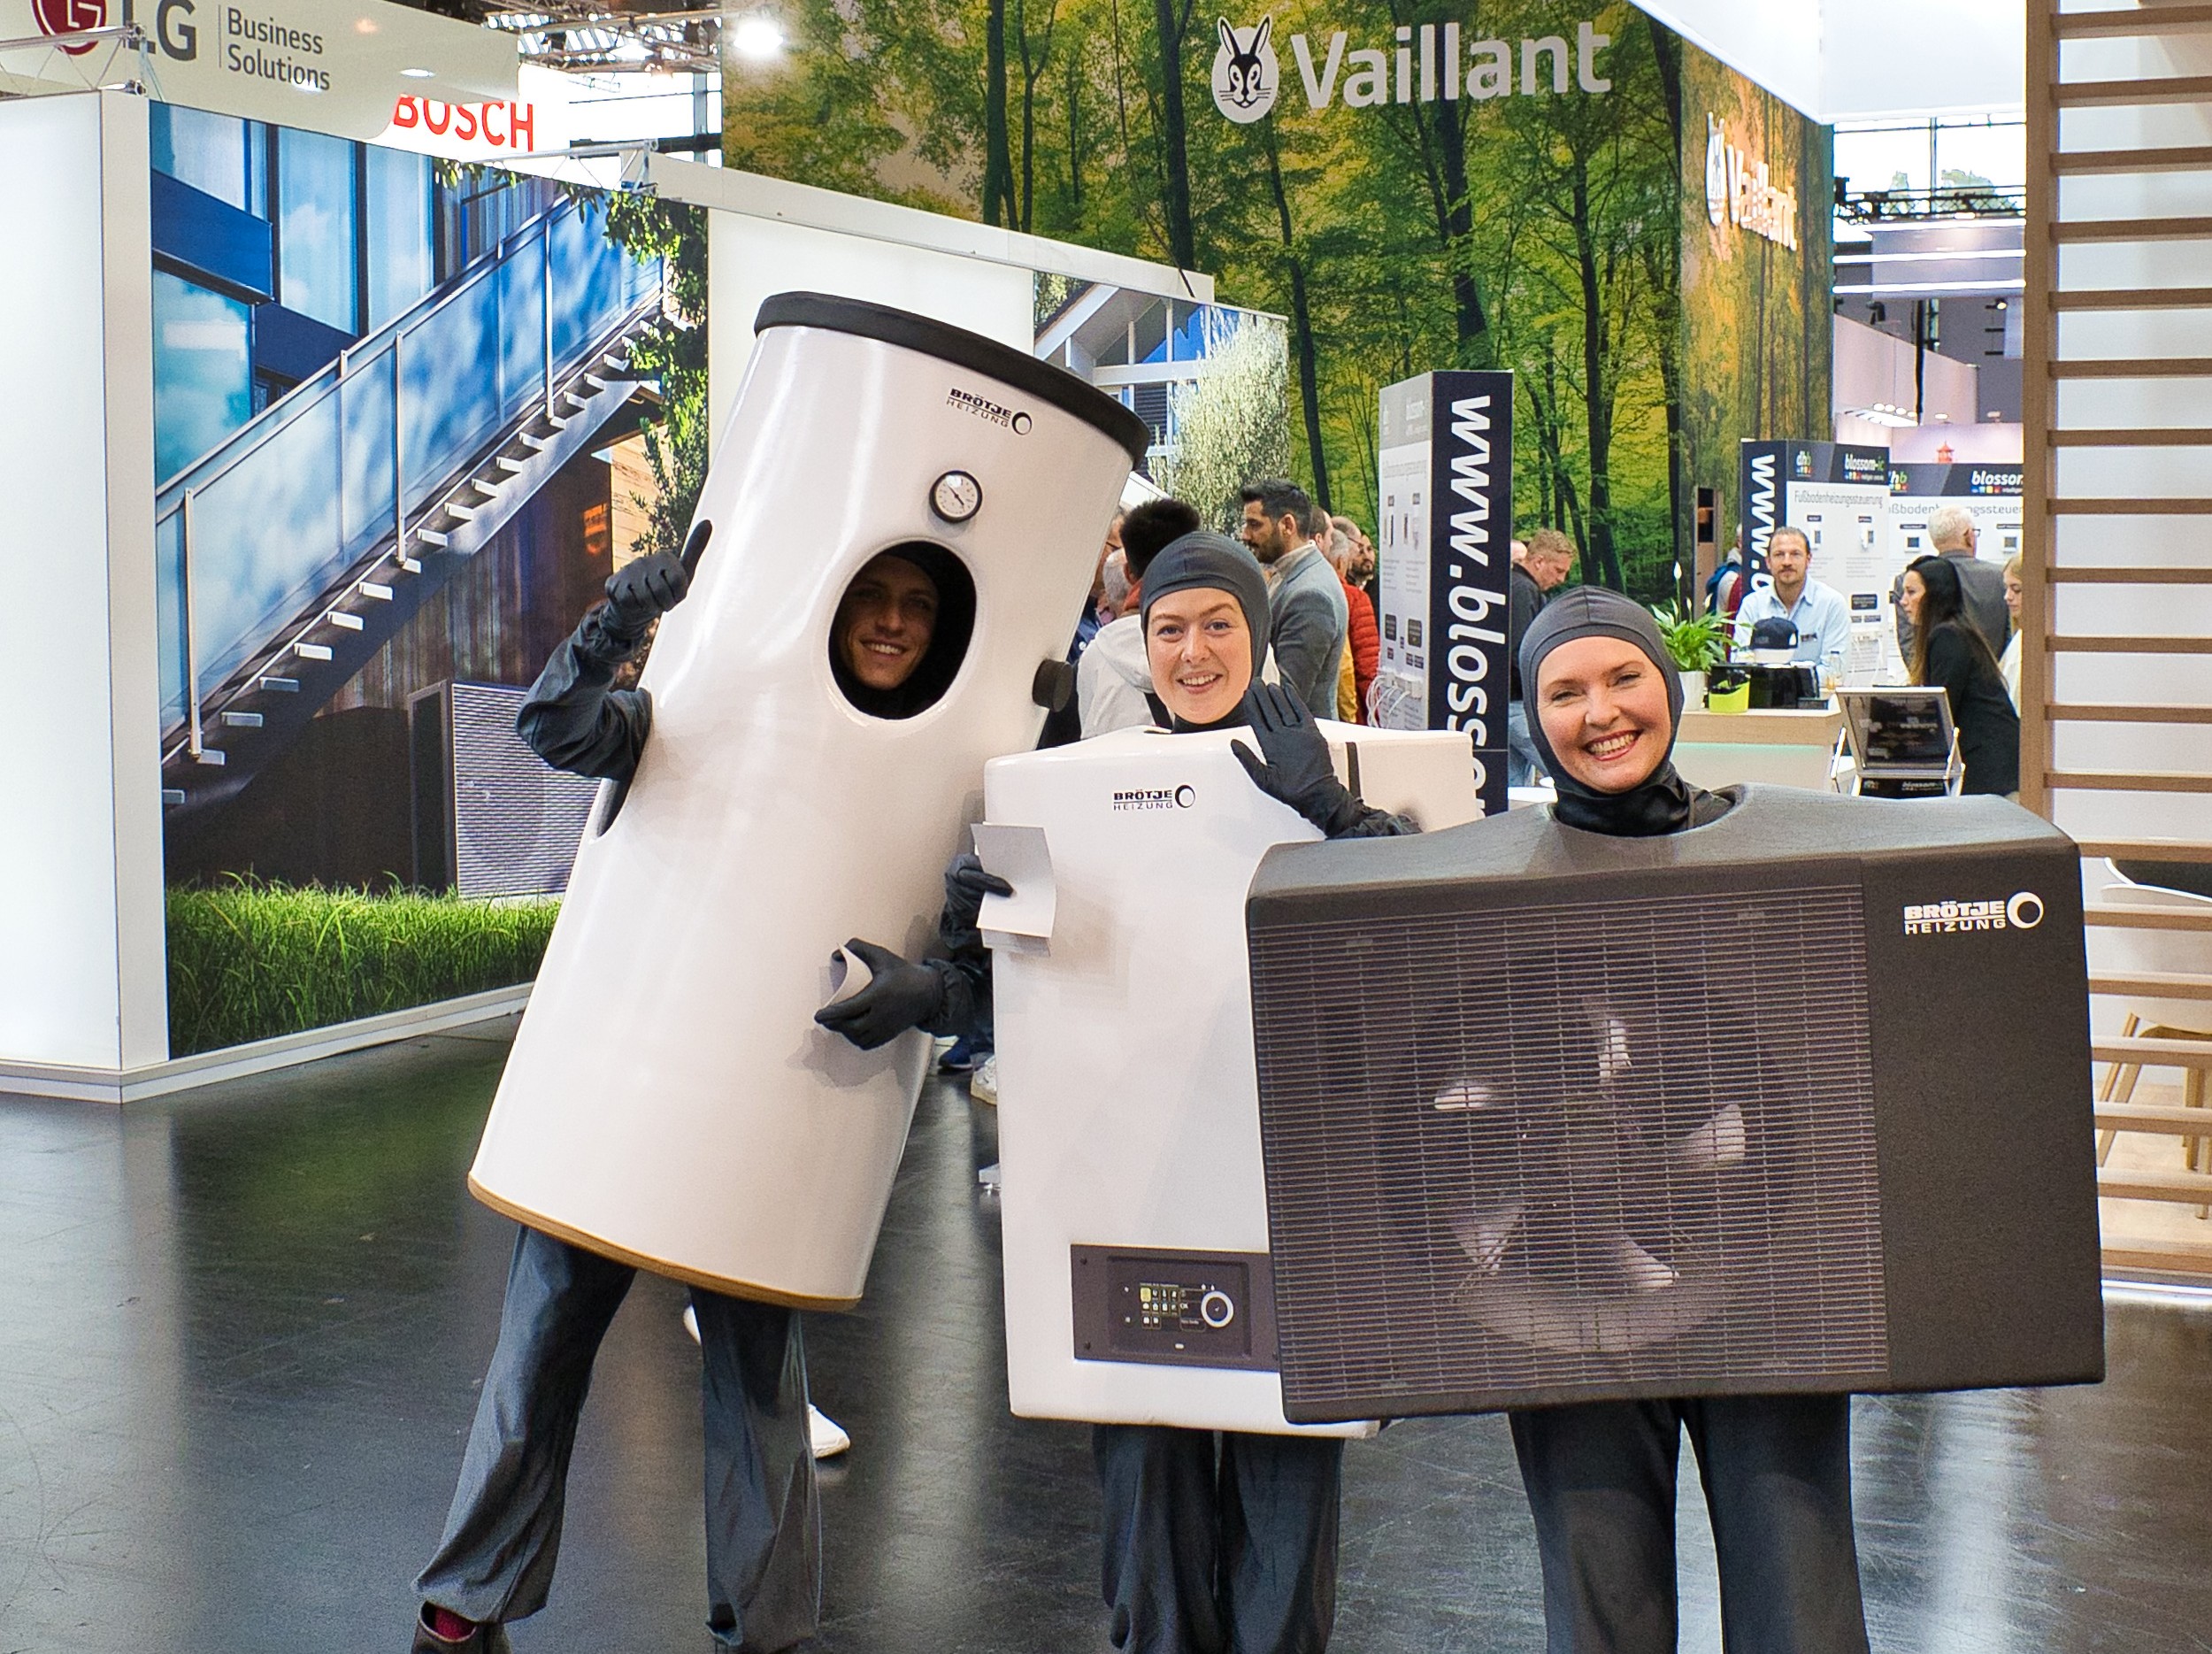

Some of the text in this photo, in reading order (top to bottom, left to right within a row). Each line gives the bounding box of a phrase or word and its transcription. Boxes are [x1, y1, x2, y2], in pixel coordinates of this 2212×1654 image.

[123, 0, 197, 61] LG
[227, 6, 323, 55] Business
[227, 43, 330, 91] Solutions
[1290, 21, 1612, 109] Vaillant
[394, 96, 534, 153] BOSCH
[946, 399, 1010, 428] HEIZUNG
[949, 388, 1013, 418] BRÖTJE
[1113, 789, 1173, 801] BRÖTJE
[1113, 802, 1174, 812] HEIZUNG
[1903, 900, 2006, 920] BRÖTJE
[1904, 918, 2007, 935] HEIZUNG
